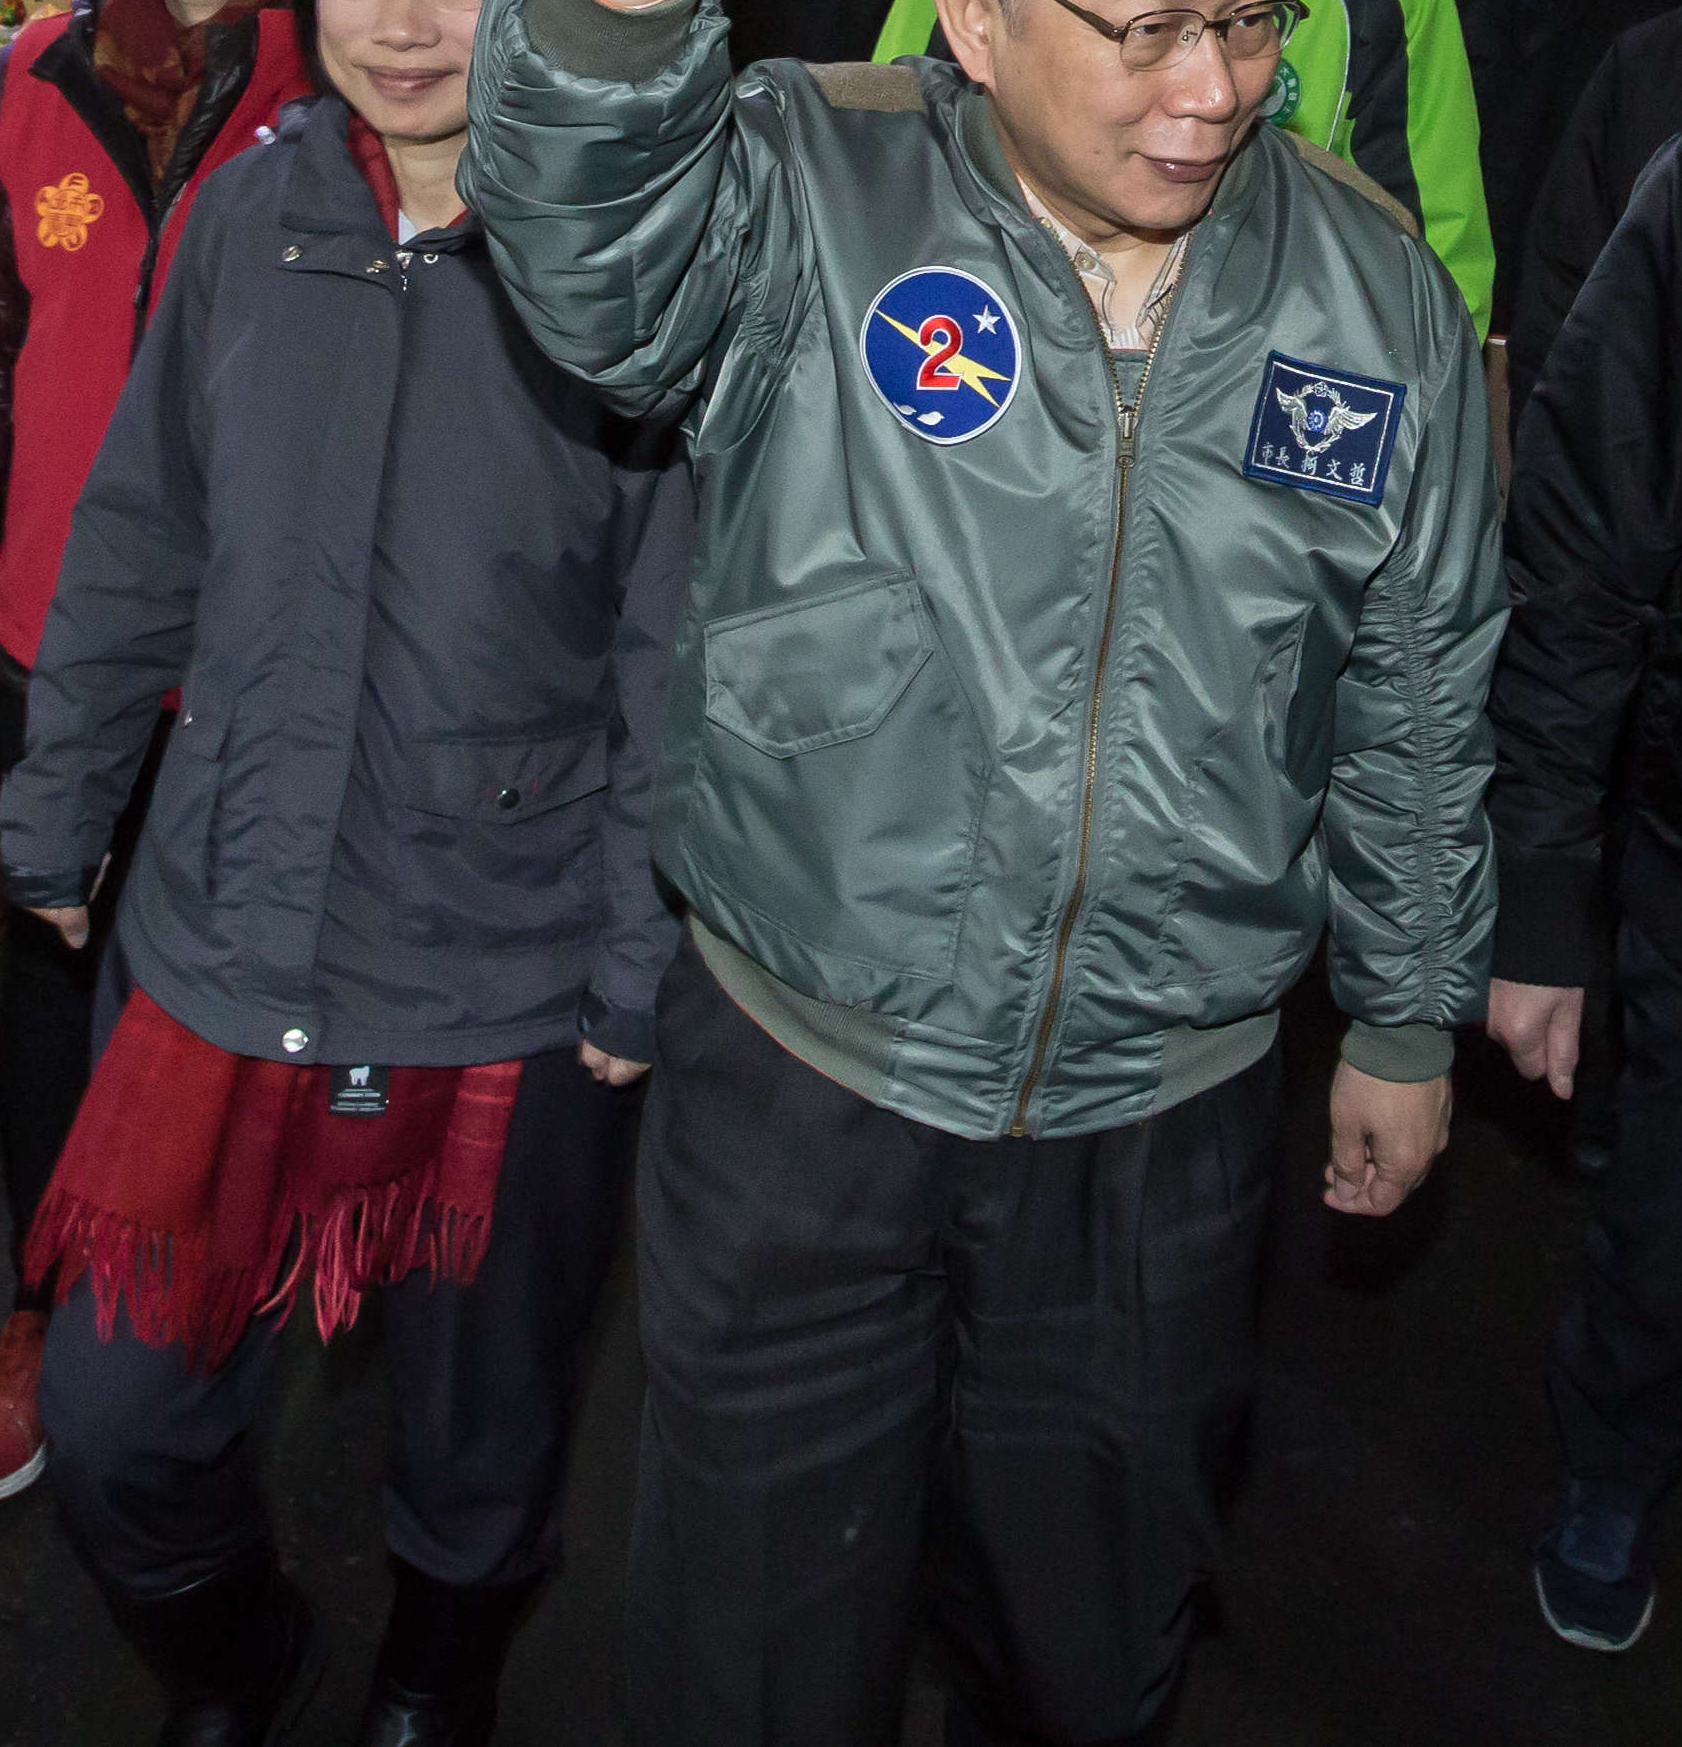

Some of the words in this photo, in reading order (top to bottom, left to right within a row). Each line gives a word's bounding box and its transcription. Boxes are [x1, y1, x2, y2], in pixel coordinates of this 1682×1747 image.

[917, 315, 963, 390] 2
[1301, 453, 1367, 486] 柯文哲
